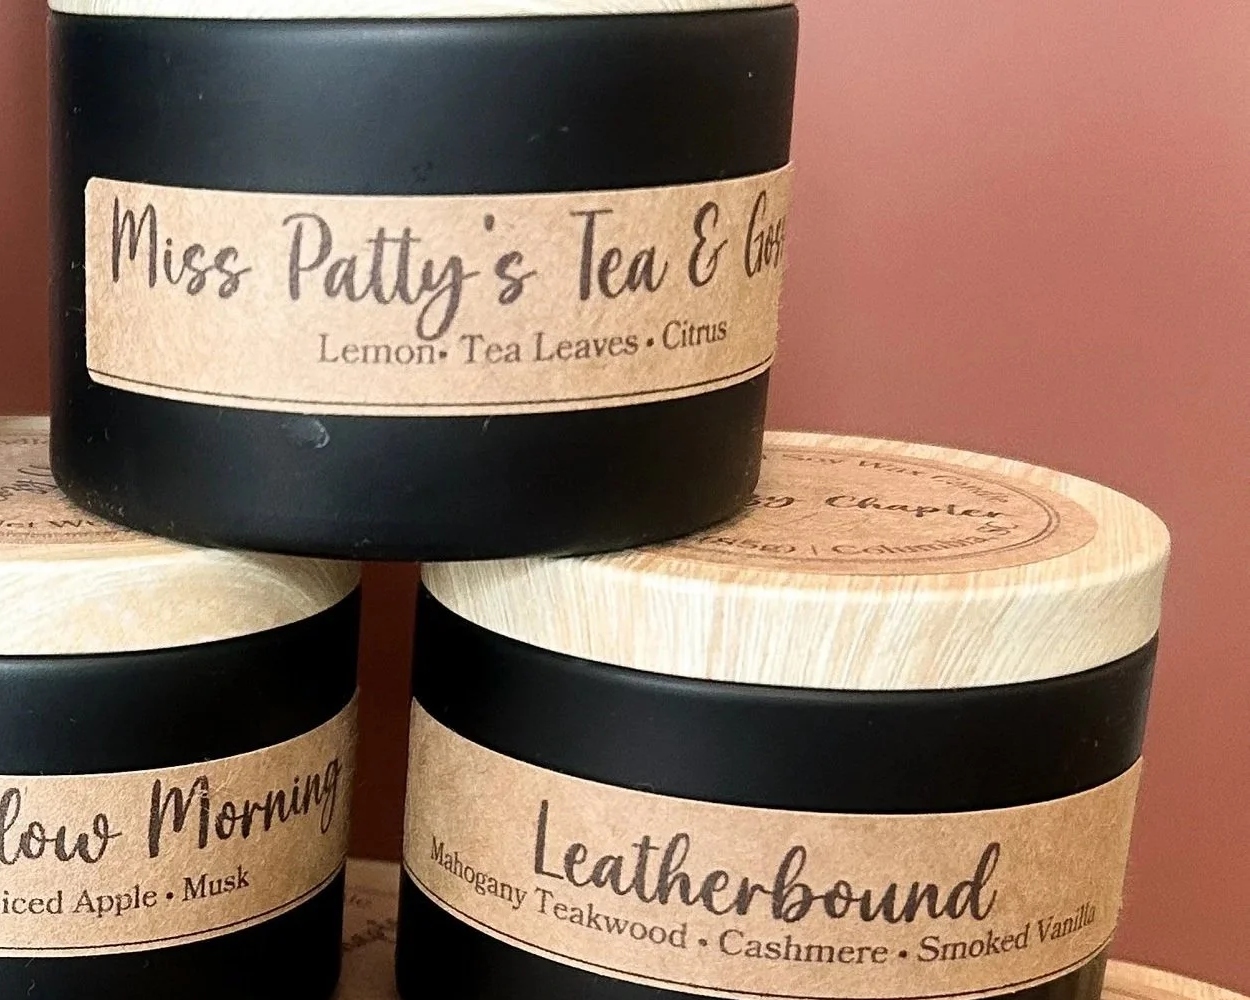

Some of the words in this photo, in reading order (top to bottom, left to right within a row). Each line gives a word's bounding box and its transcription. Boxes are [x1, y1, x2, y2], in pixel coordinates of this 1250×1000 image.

[111, 195, 253, 298] Miss
[282, 211, 538, 341] Patty's
[570, 206, 669, 300] Tea
[688, 200, 729, 288] &
[459, 335, 522, 365] Tea
[534, 330, 640, 363] Leaves
[661, 317, 728, 352] Citrus
[825, 495, 1020, 518] Chapter
[148, 754, 344, 858] Morning
[73, 882, 159, 921] Apple
[181, 865, 250, 903] Musk
[429, 834, 529, 910] Mahogany
[533, 886, 689, 952] Teakwood
[719, 926, 890, 967] Cashmere
[917, 924, 1029, 964] Smoked
[1037, 901, 1097, 943] Vanilla
[533, 799, 1001, 925] Leatherbound
